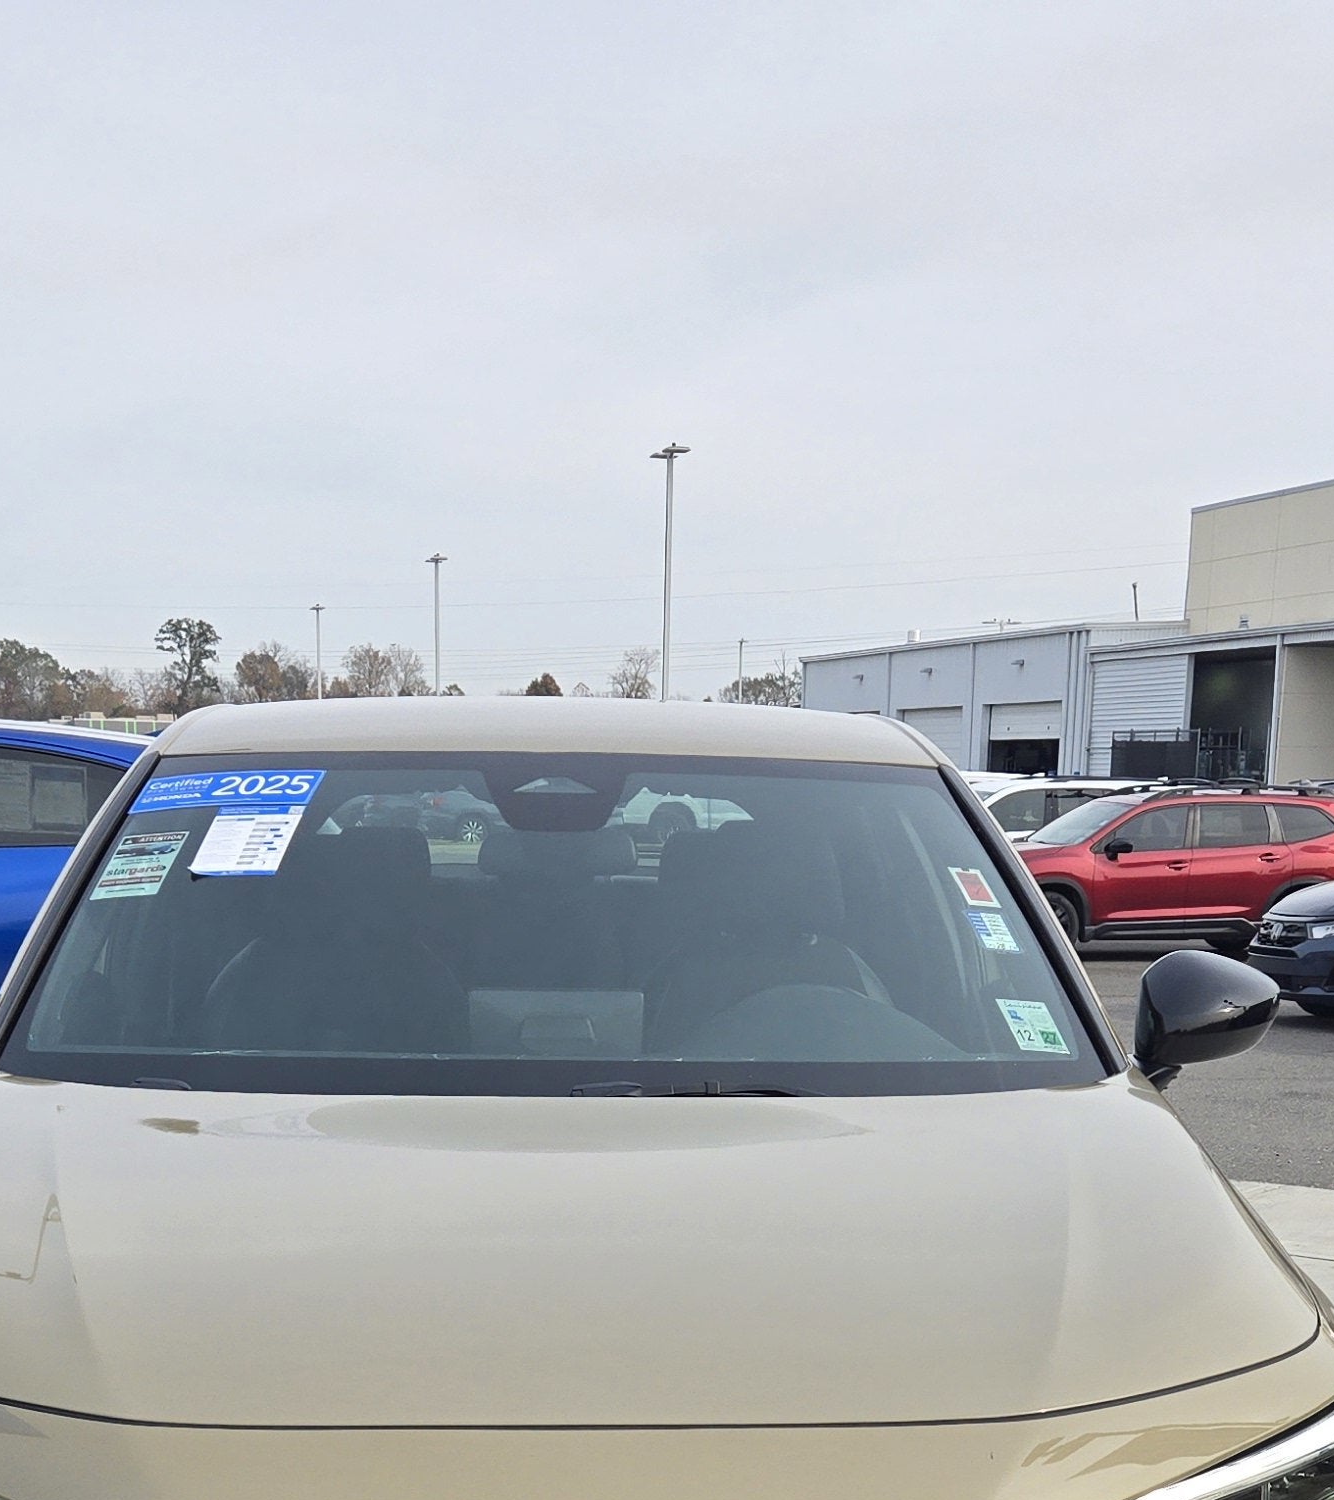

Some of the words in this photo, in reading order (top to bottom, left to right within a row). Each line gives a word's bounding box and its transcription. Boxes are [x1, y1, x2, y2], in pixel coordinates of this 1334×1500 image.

[149, 777, 214, 791] Certified
[211, 775, 314, 796] 2025
[152, 792, 202, 802] HONDA
[1016, 1029, 1035, 1042] 12
[1041, 1031, 1058, 1045] 27
